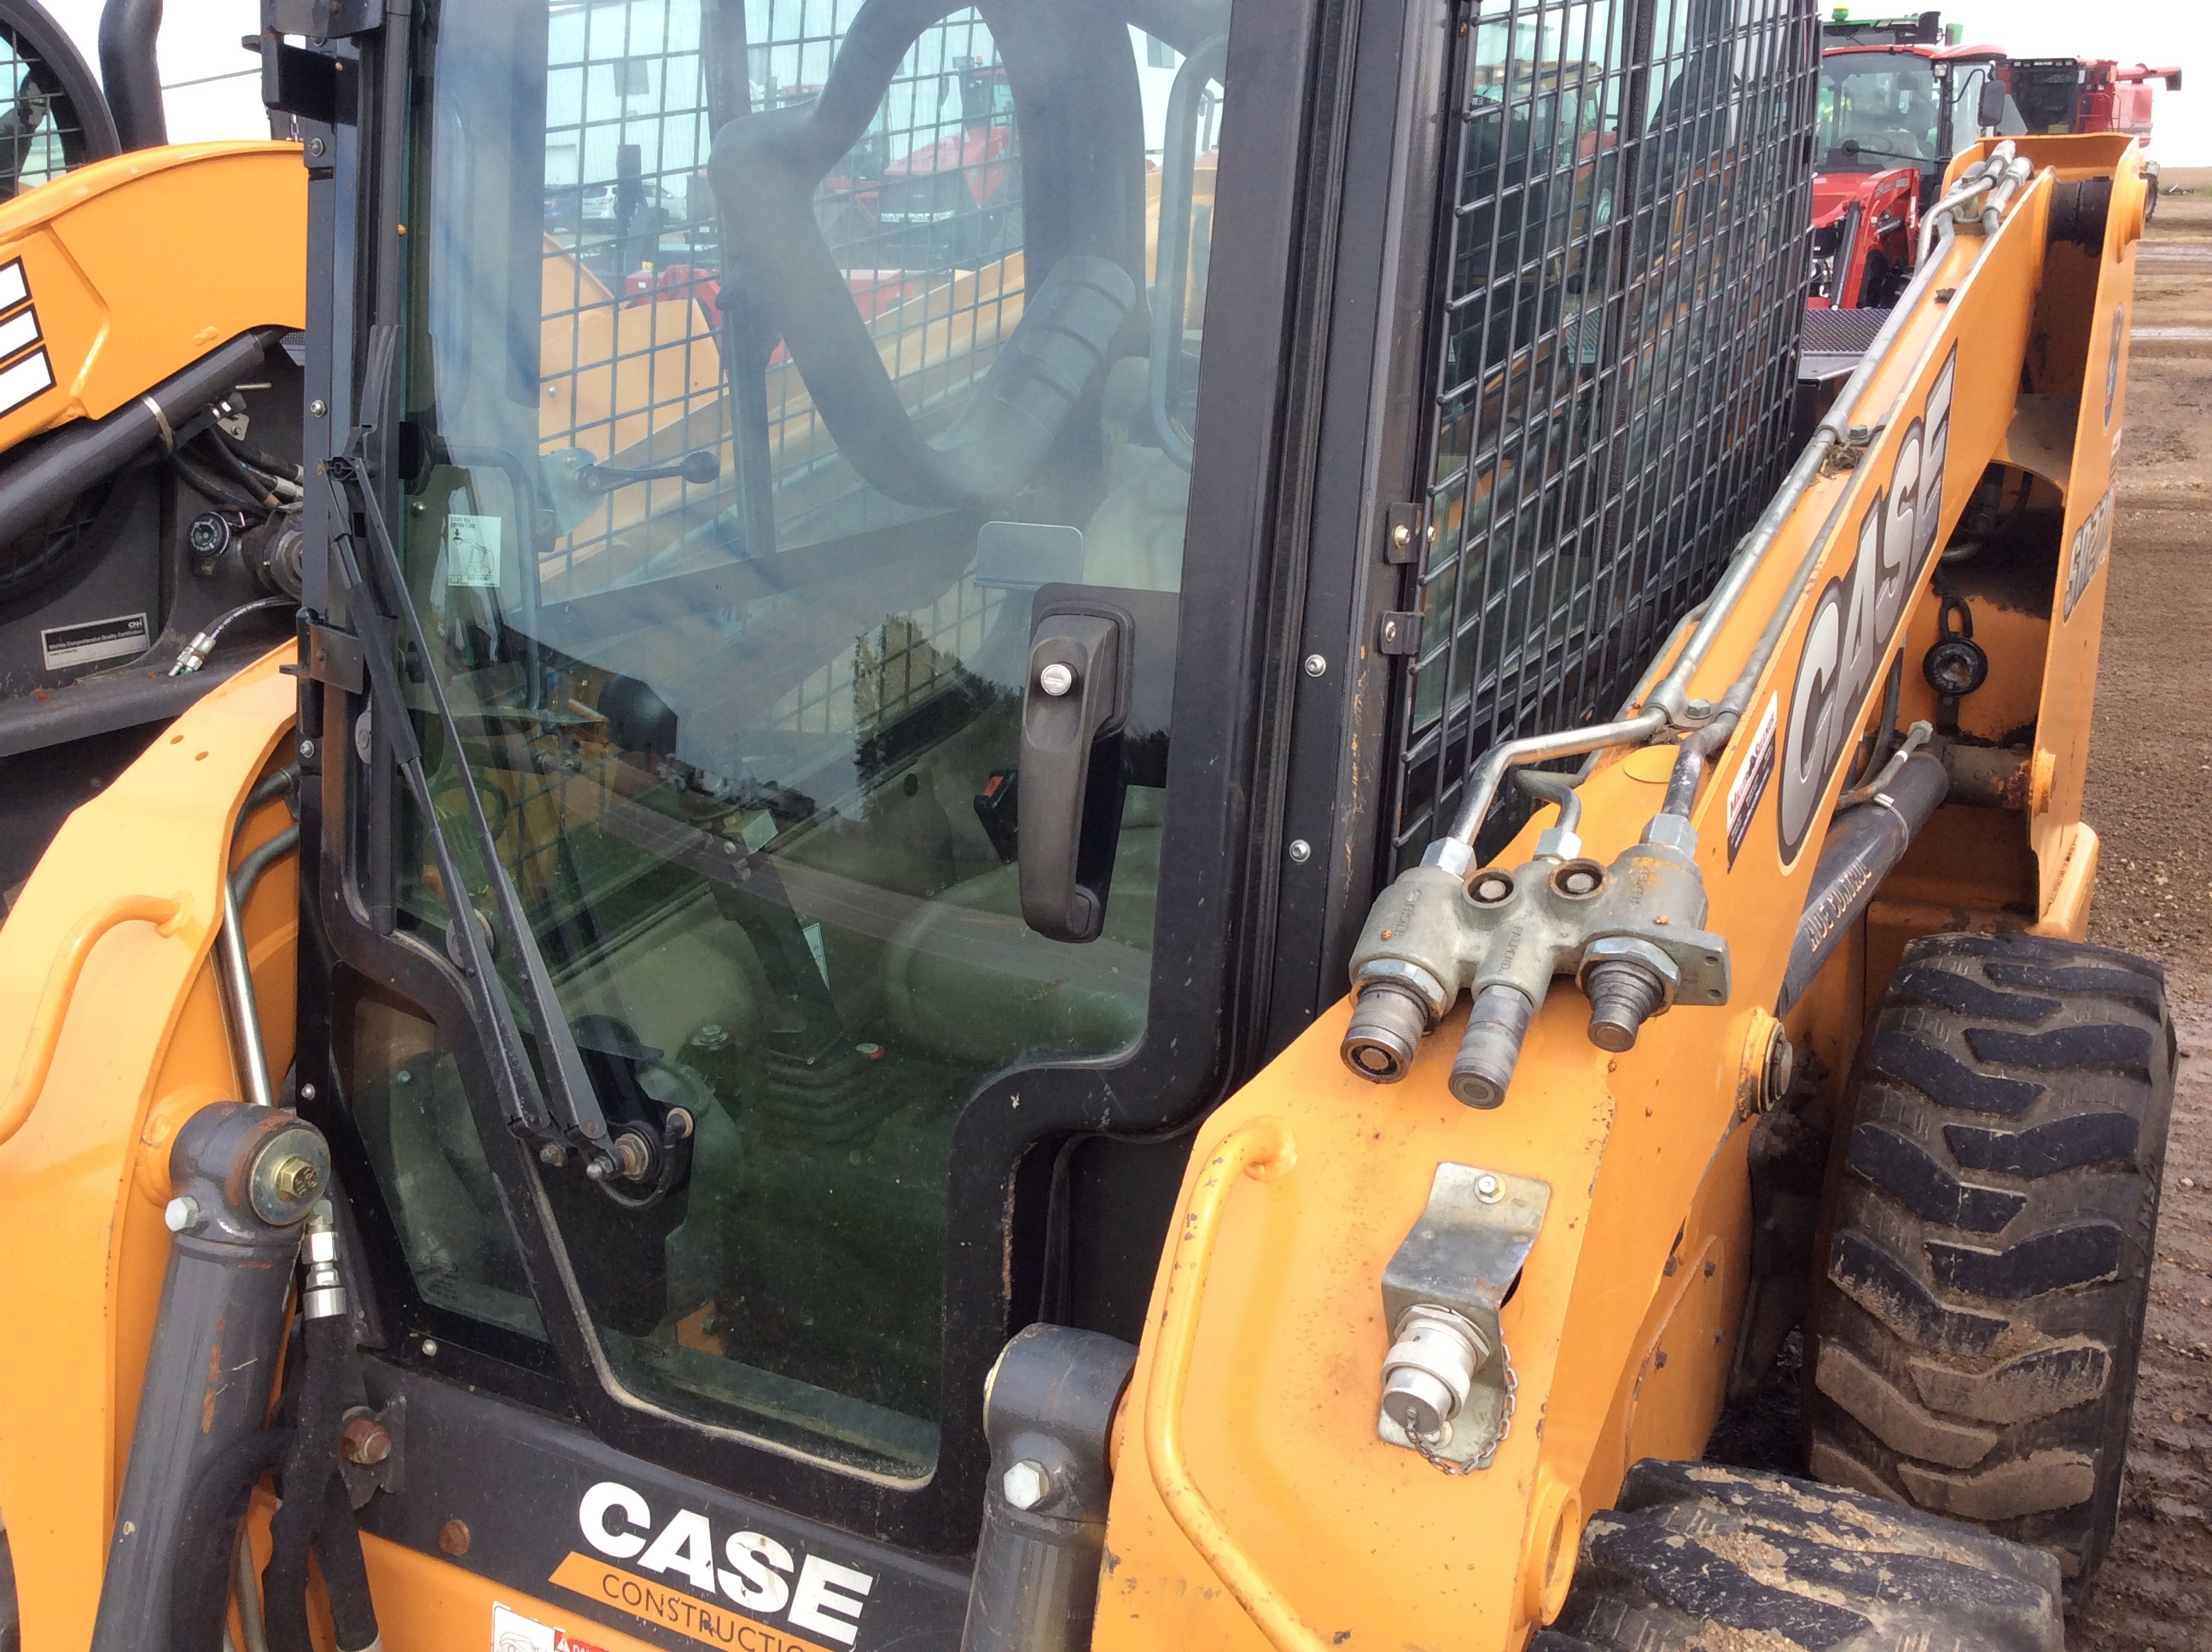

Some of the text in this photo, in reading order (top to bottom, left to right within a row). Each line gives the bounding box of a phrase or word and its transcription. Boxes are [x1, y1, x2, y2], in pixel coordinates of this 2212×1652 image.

[1779, 341, 1956, 862] CASE
[1804, 904, 1834, 952] RIDE
[579, 1481, 874, 1646] CASE
